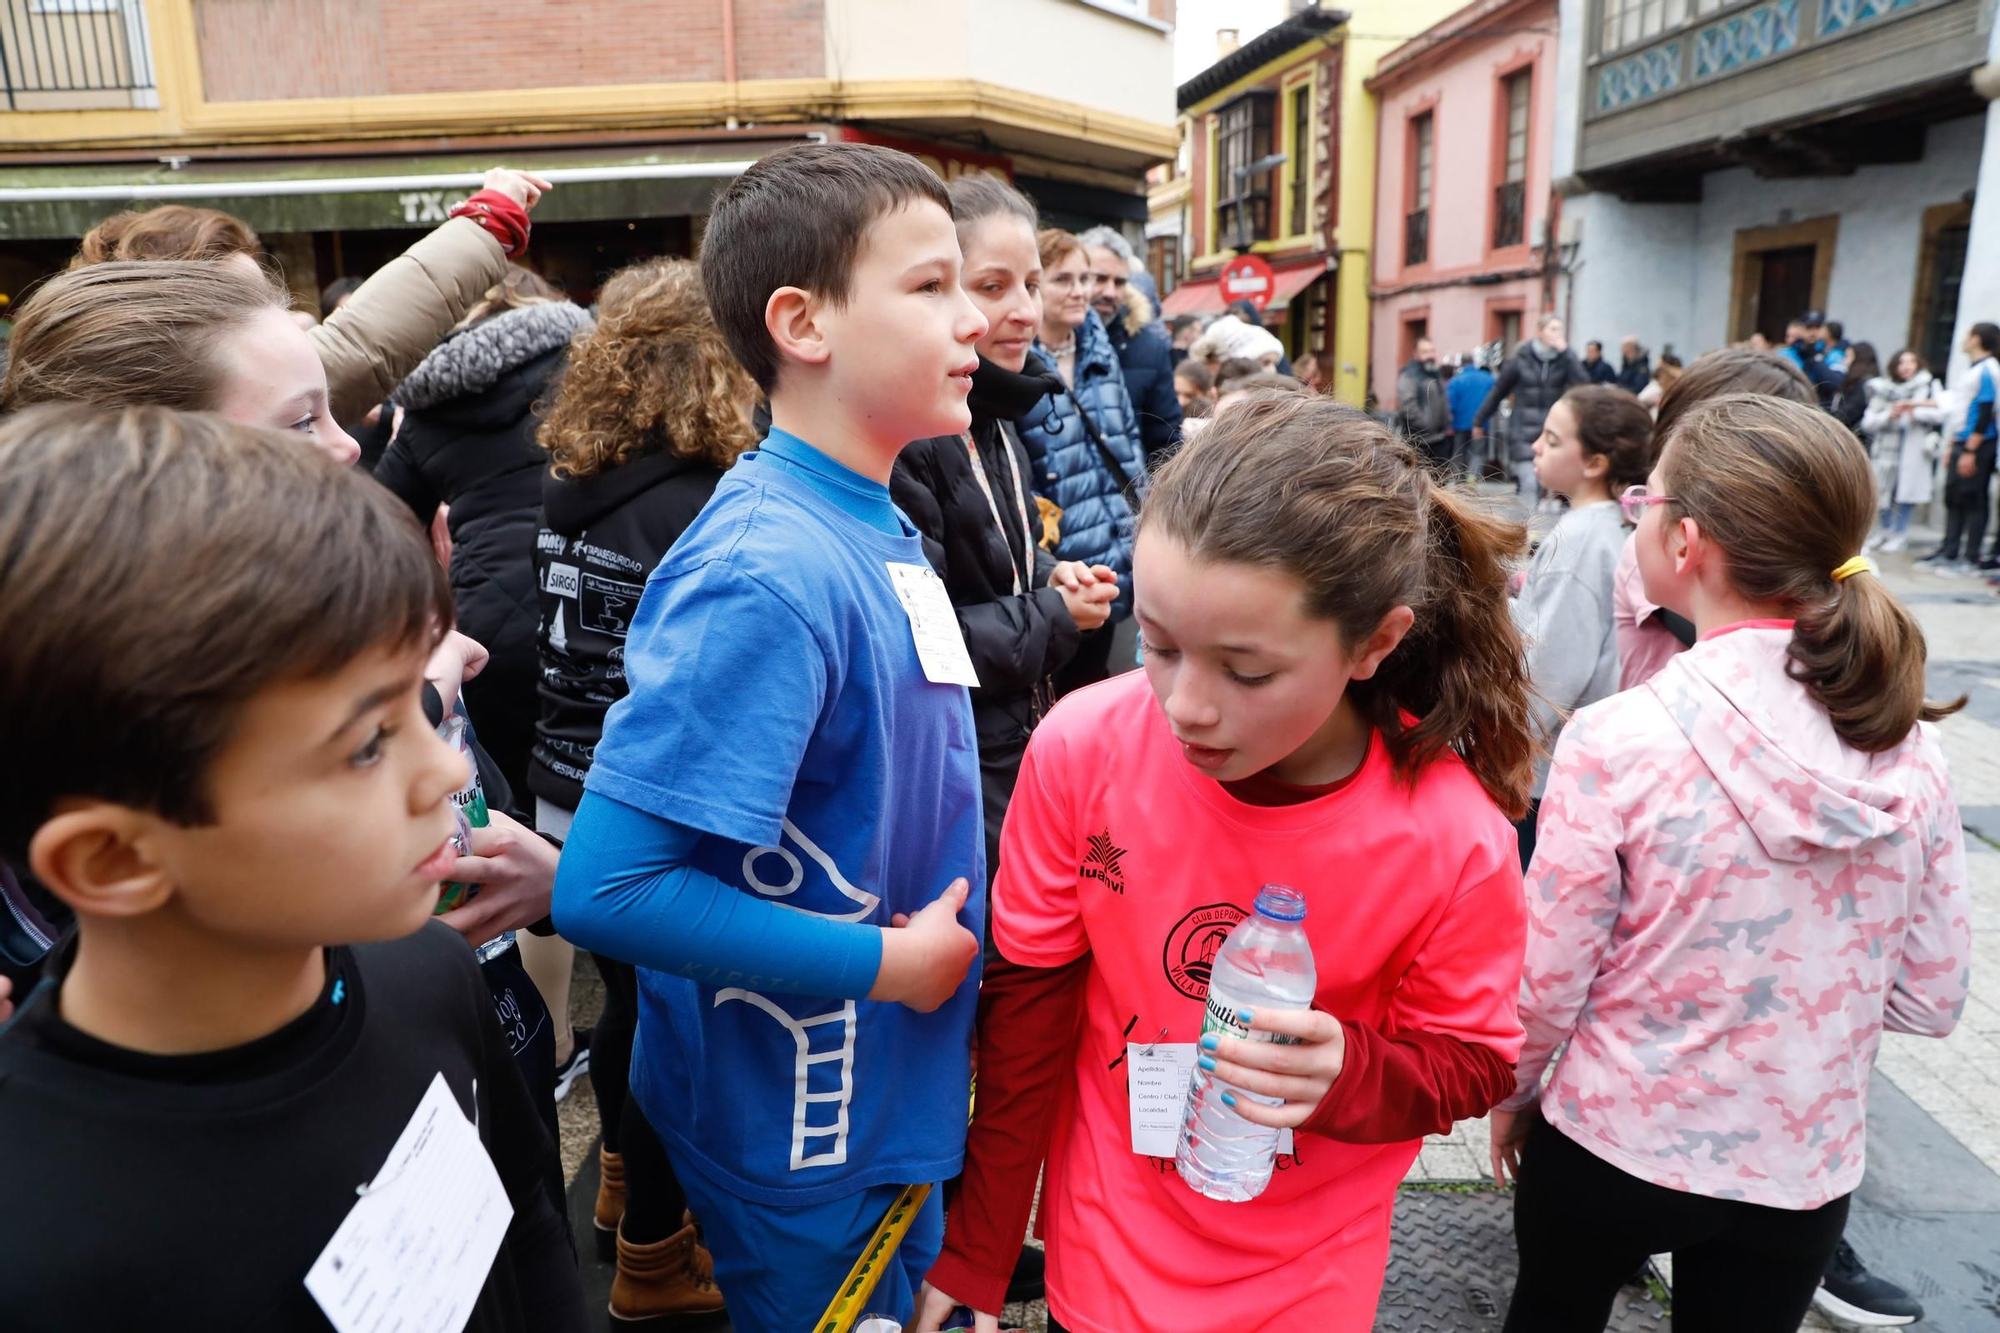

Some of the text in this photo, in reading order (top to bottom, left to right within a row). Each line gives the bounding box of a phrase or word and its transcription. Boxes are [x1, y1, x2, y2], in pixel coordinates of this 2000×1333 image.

[550, 573, 577, 592] SIRGO
[1079, 865, 1124, 894] luanvi
[1191, 911, 1213, 925] CLUB
[1170, 965, 1196, 993] VILLA
